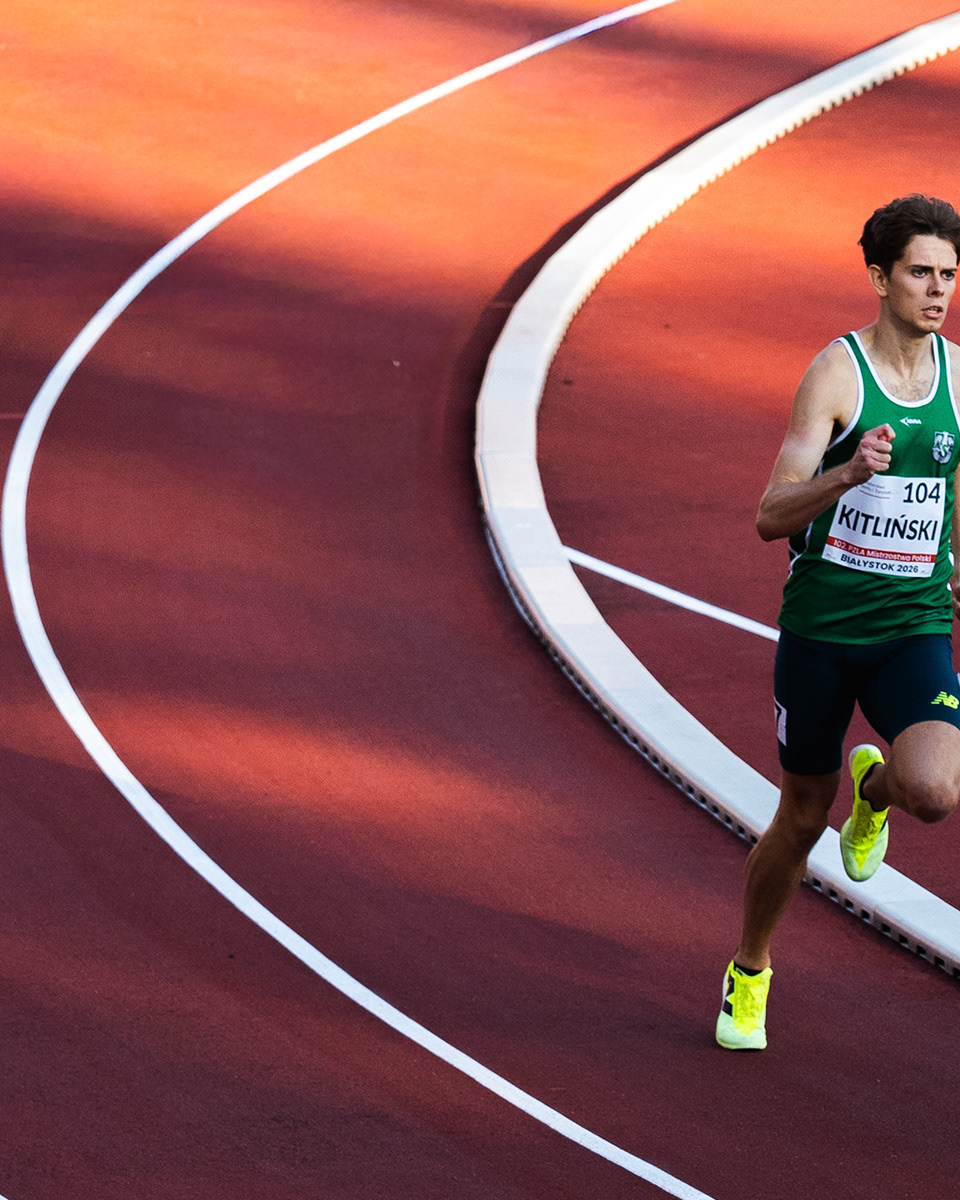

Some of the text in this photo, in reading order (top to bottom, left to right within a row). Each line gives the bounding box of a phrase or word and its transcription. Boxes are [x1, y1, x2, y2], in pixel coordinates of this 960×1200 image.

[903, 482, 941, 504] 104
[837, 504, 939, 541] KITLIŃSKI
[833, 539, 847, 550] 102.
[840, 553, 919, 574] BIAŁYSTOK 2026
